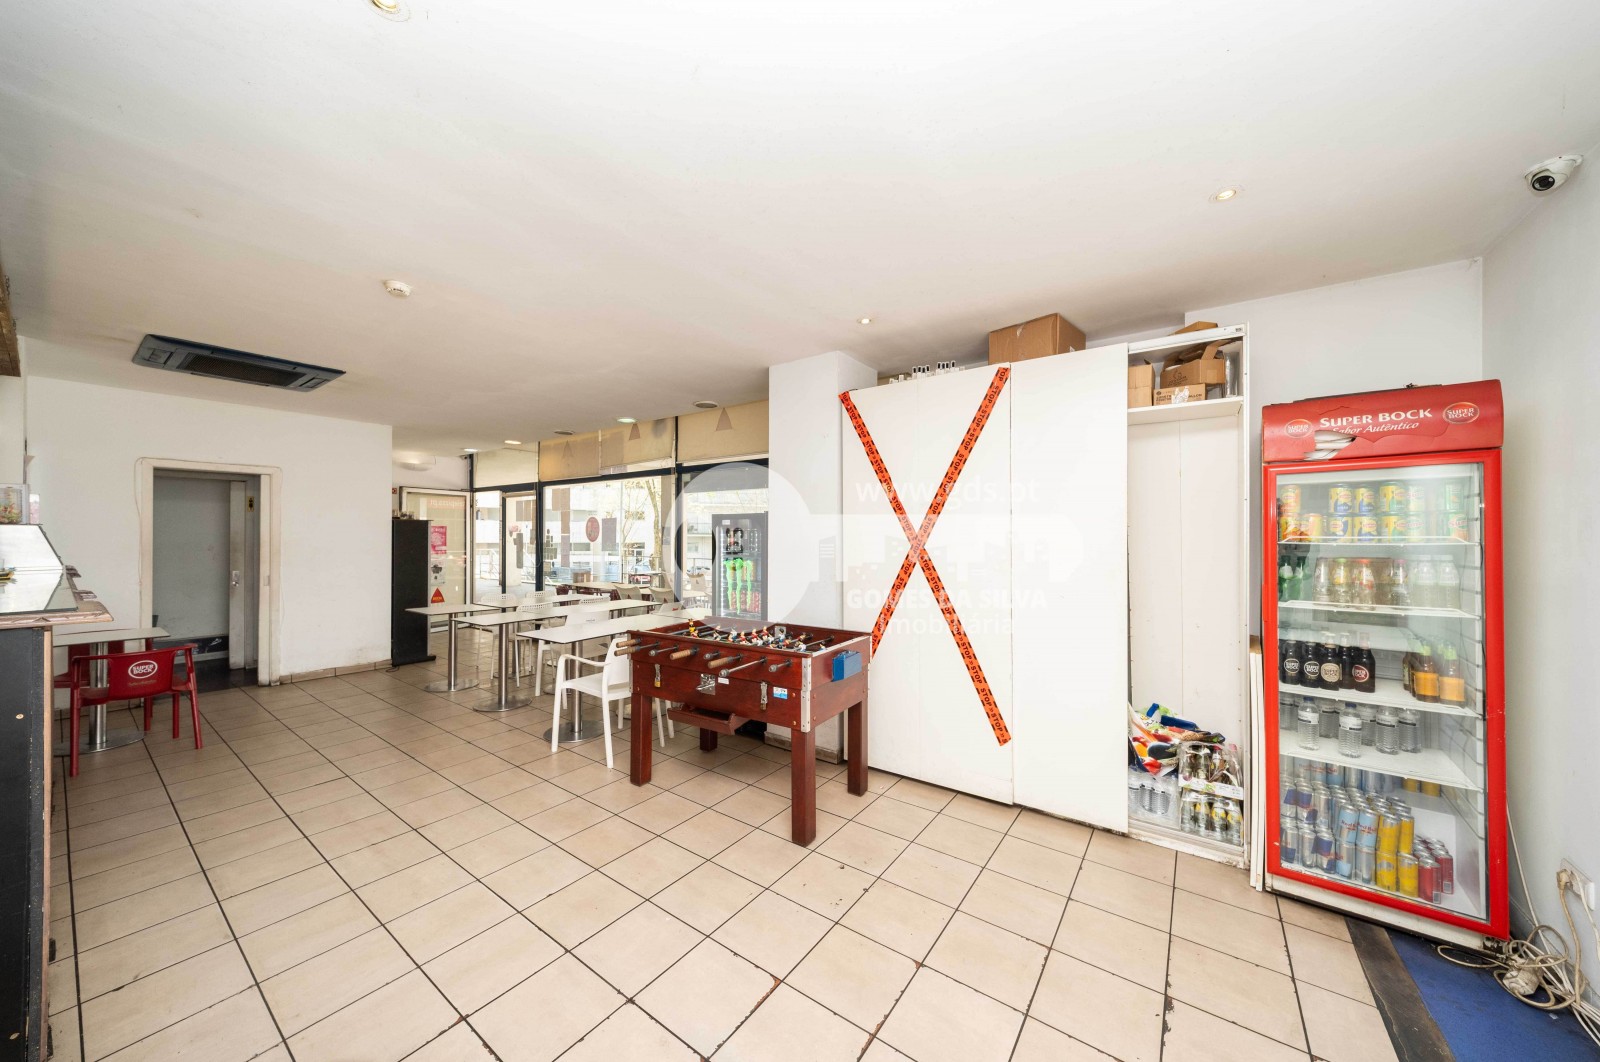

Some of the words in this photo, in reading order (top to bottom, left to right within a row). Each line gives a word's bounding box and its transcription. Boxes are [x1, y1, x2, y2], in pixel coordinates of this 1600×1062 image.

[986, 384, 998, 403] STOP
[974, 408, 987, 427] STOP
[1319, 414, 1373, 428] SUPER
[1378, 408, 1433, 422] BOCK
[1447, 407, 1475, 415] SUPER
[963, 432, 975, 450] STOP
[952, 453, 964, 471] STOP
[941, 475, 954, 493] STOP
[931, 498, 942, 514] STOP
[921, 517, 933, 534] STOP
[902, 558, 913, 575] STOP
[856, 423, 867, 438] STOP
[864, 439, 875, 455] STOP
[873, 458, 884, 474] STOP
[883, 478, 893, 492] STOP
[891, 495, 902, 511] STOP
[901, 515, 913, 532] STOP
[920, 554, 931, 572] STOP
[930, 576, 941, 593] STOP
[940, 598, 952, 616] STOP
[949, 618, 961, 636] STOP
[960, 641, 972, 660] STOP
[970, 665, 982, 684] STOP
[980, 687, 992, 707] STOP
[991, 711, 1003, 732] STOP
[894, 577, 905, 593] STOP
[869, 633, 879, 648] STO
